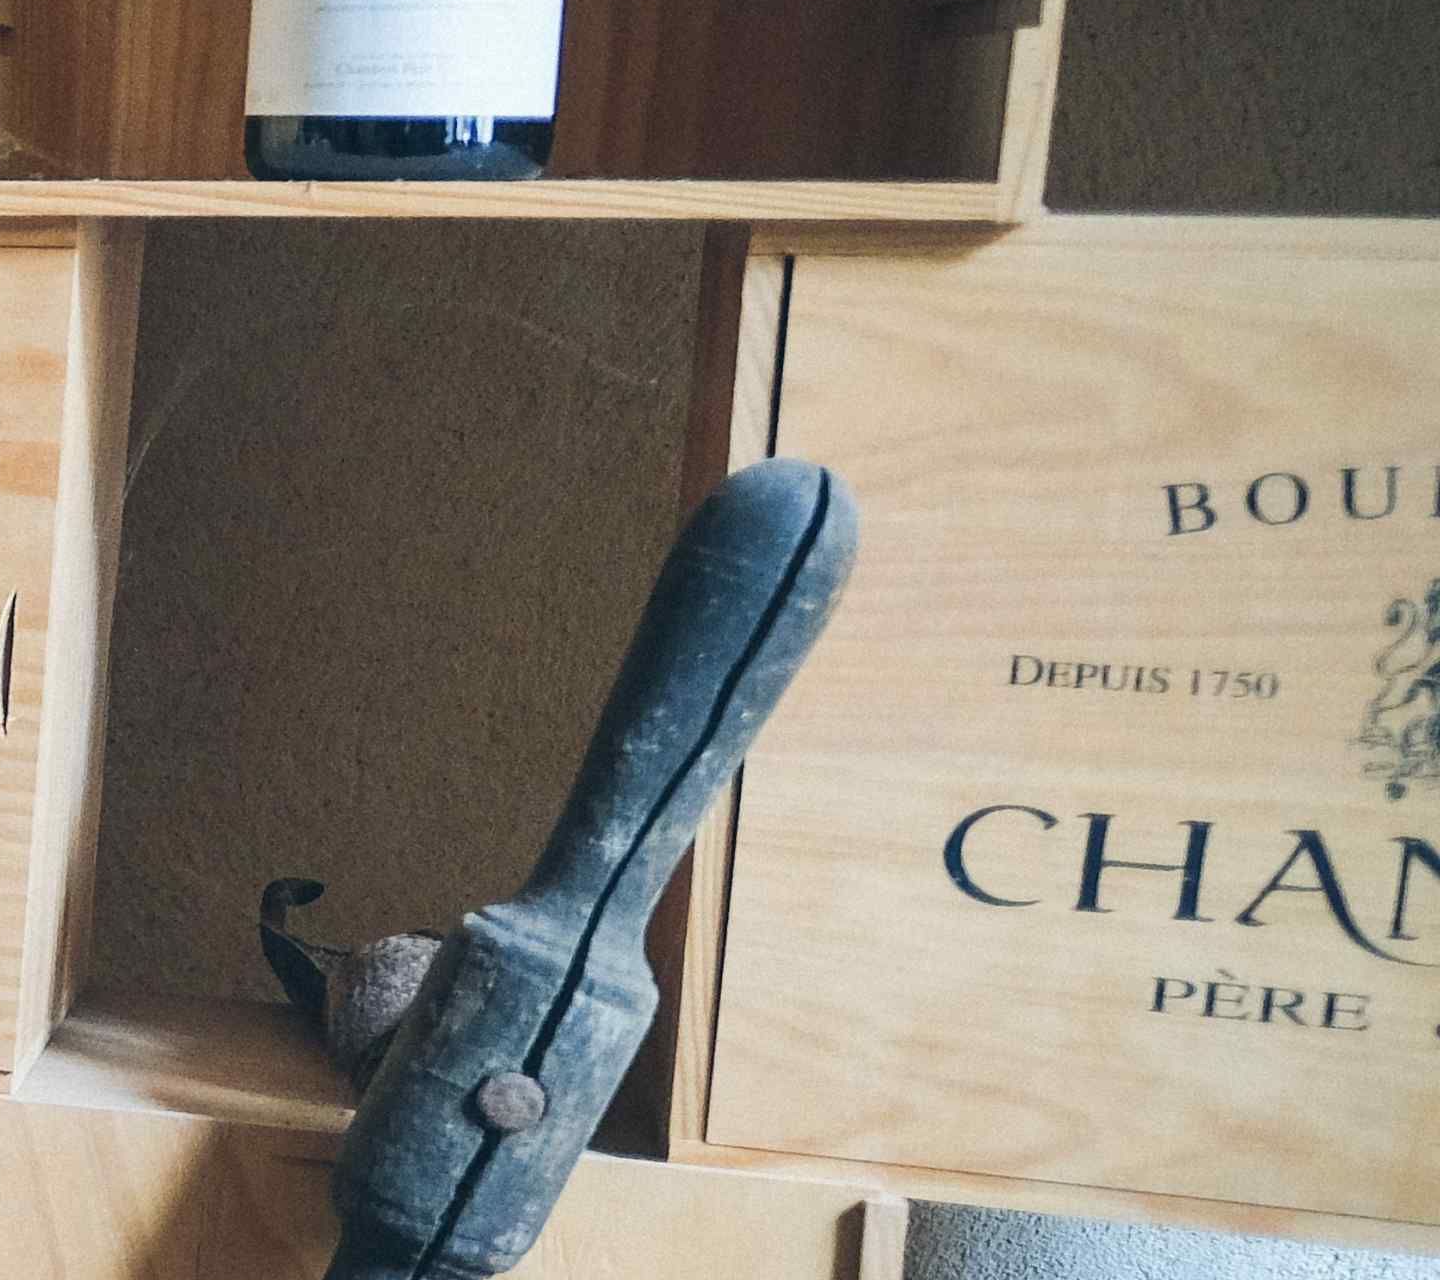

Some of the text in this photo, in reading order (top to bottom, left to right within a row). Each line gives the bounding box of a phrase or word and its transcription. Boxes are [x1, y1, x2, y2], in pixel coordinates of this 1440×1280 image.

[1162, 462, 1440, 536] BOU
[1008, 653, 1280, 703] DEPUIS 1750
[1147, 968, 1370, 1035] PÈRE
